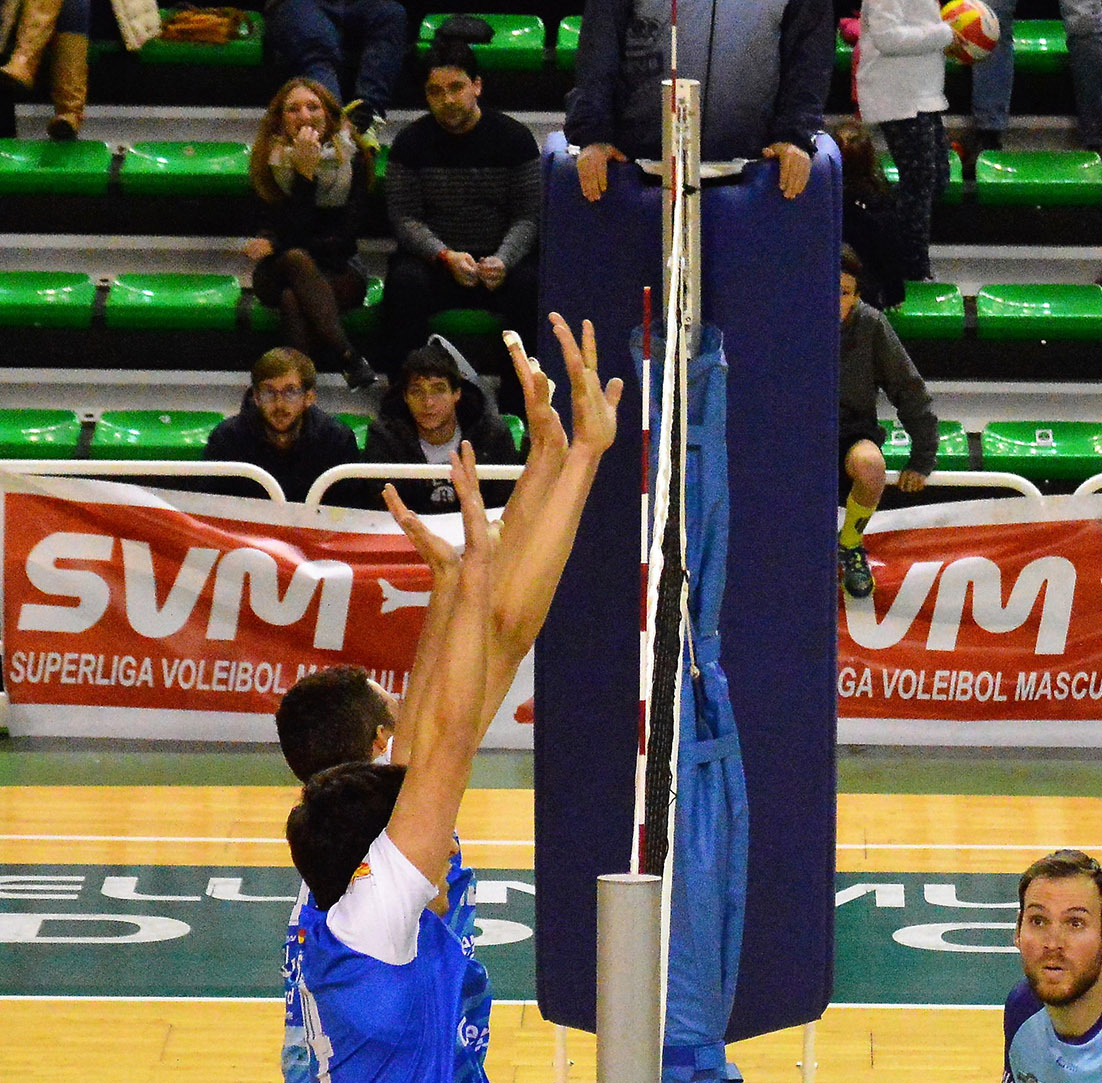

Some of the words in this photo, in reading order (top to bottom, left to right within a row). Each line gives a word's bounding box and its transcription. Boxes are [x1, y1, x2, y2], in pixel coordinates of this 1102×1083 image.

[17, 531, 354, 651] SVM
[843, 556, 1077, 655] VM
[9, 651, 153, 687] SUPERLIGA
[162, 658, 287, 694] VOLEIBOL
[883, 668, 1007, 702] VOLEIBOL
